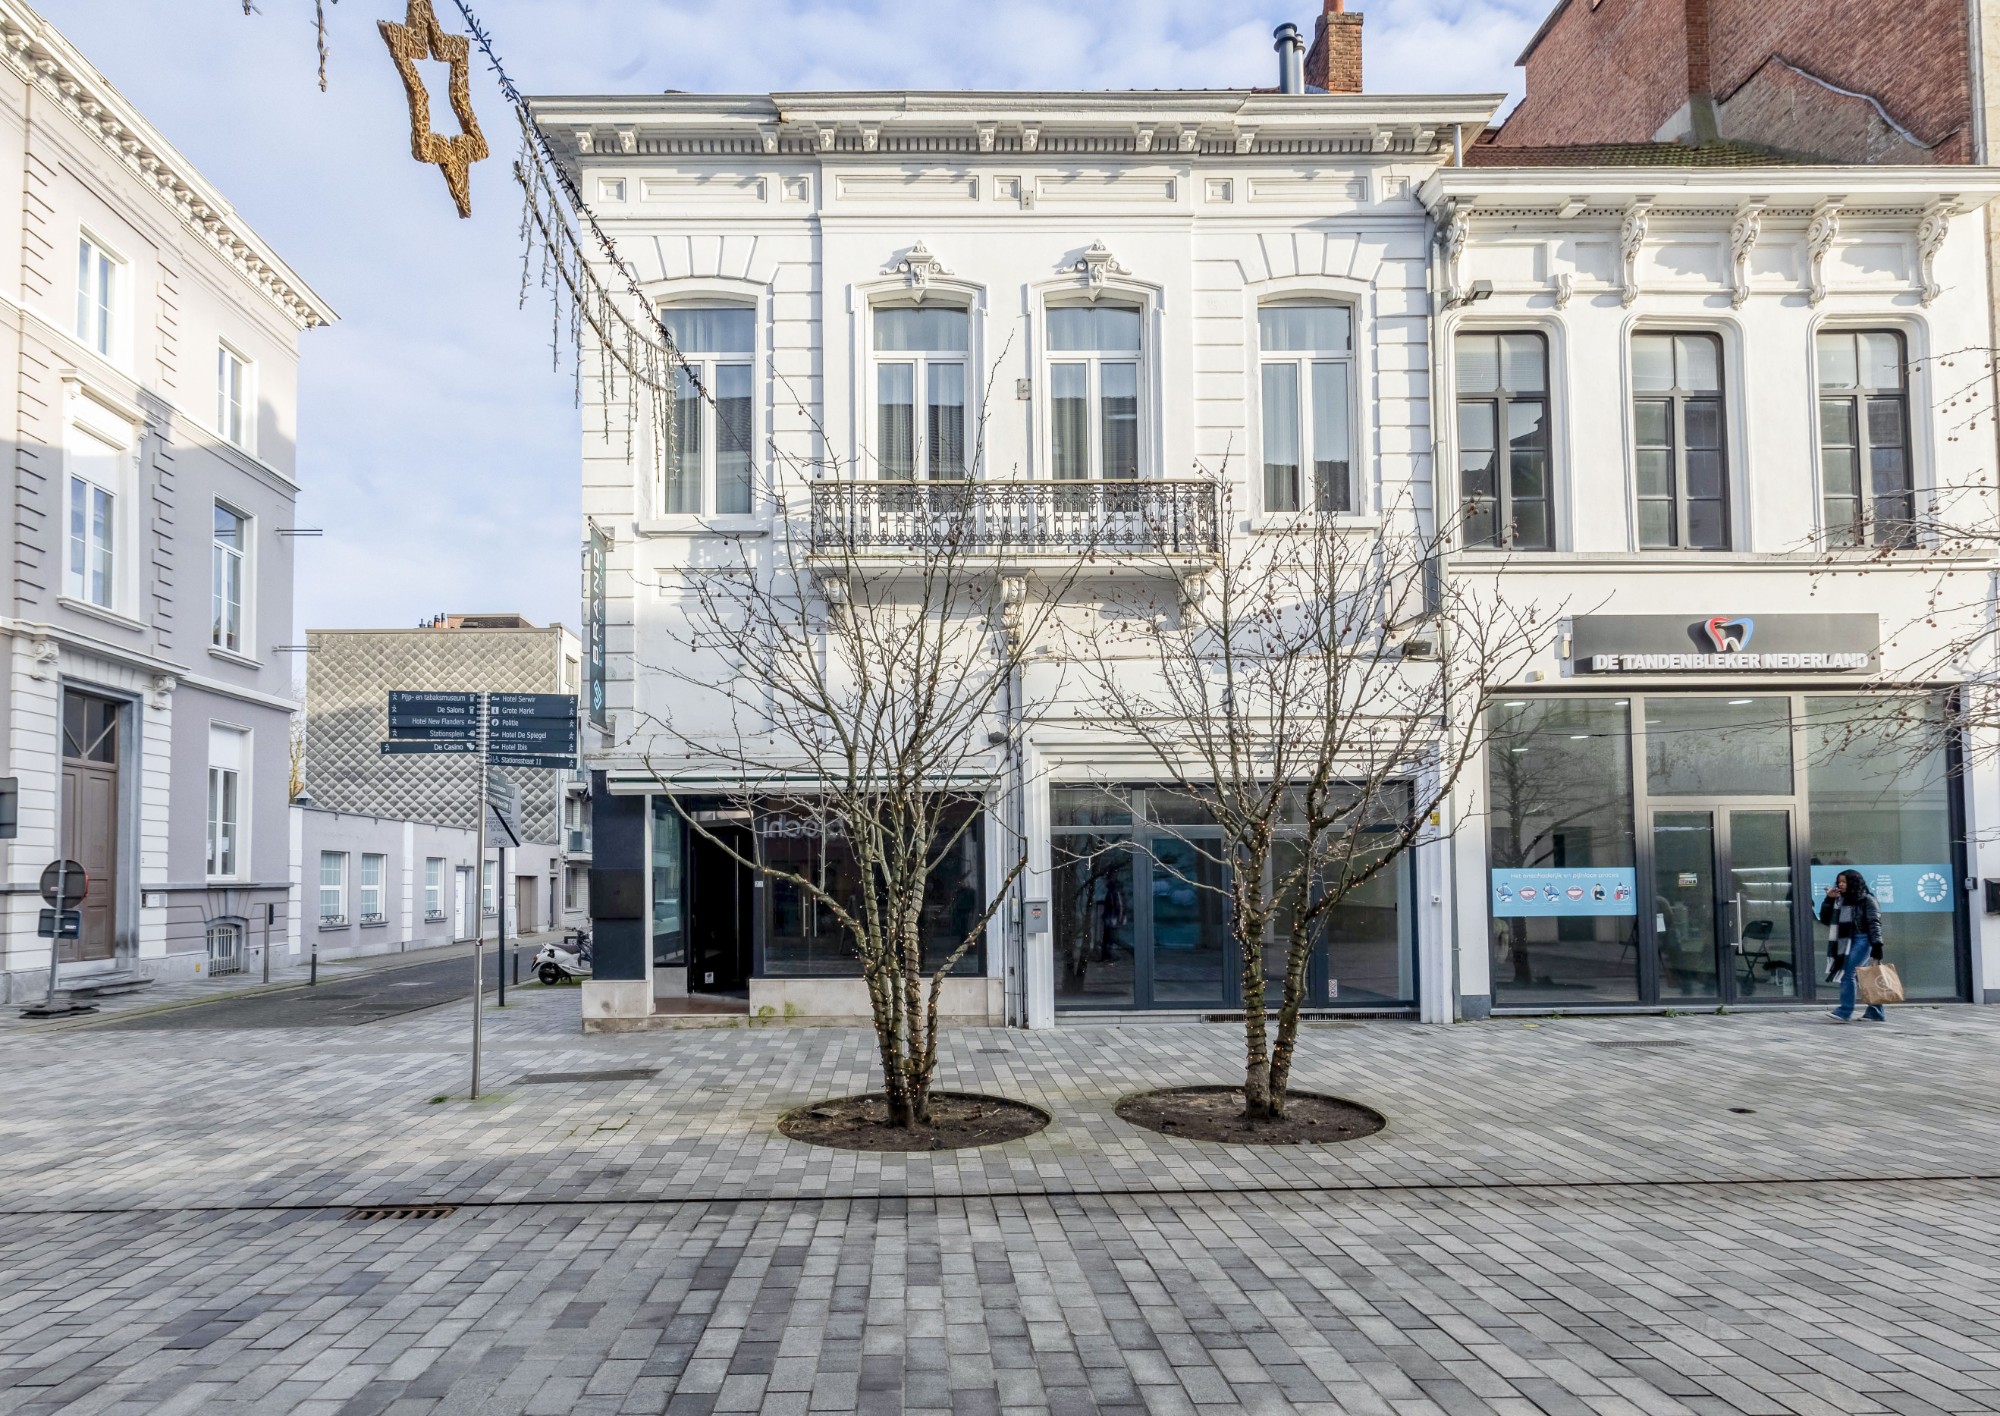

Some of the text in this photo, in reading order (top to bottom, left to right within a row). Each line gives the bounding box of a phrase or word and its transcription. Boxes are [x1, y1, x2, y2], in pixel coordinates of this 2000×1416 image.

[1594, 653, 1869, 670] DE TANDENBLEKER NEDERLAND
[401, 693, 414, 702] Pijp-
[424, 693, 466, 701] tabaksmuseum
[446, 706, 465, 714] Salons
[429, 730, 465, 738] Stationsplein
[526, 732, 547, 740] Spiegel
[433, 743, 464, 751] De Casino
[501, 743, 528, 751] Hotel Ibis
[501, 756, 535, 765] Stationsstraat
